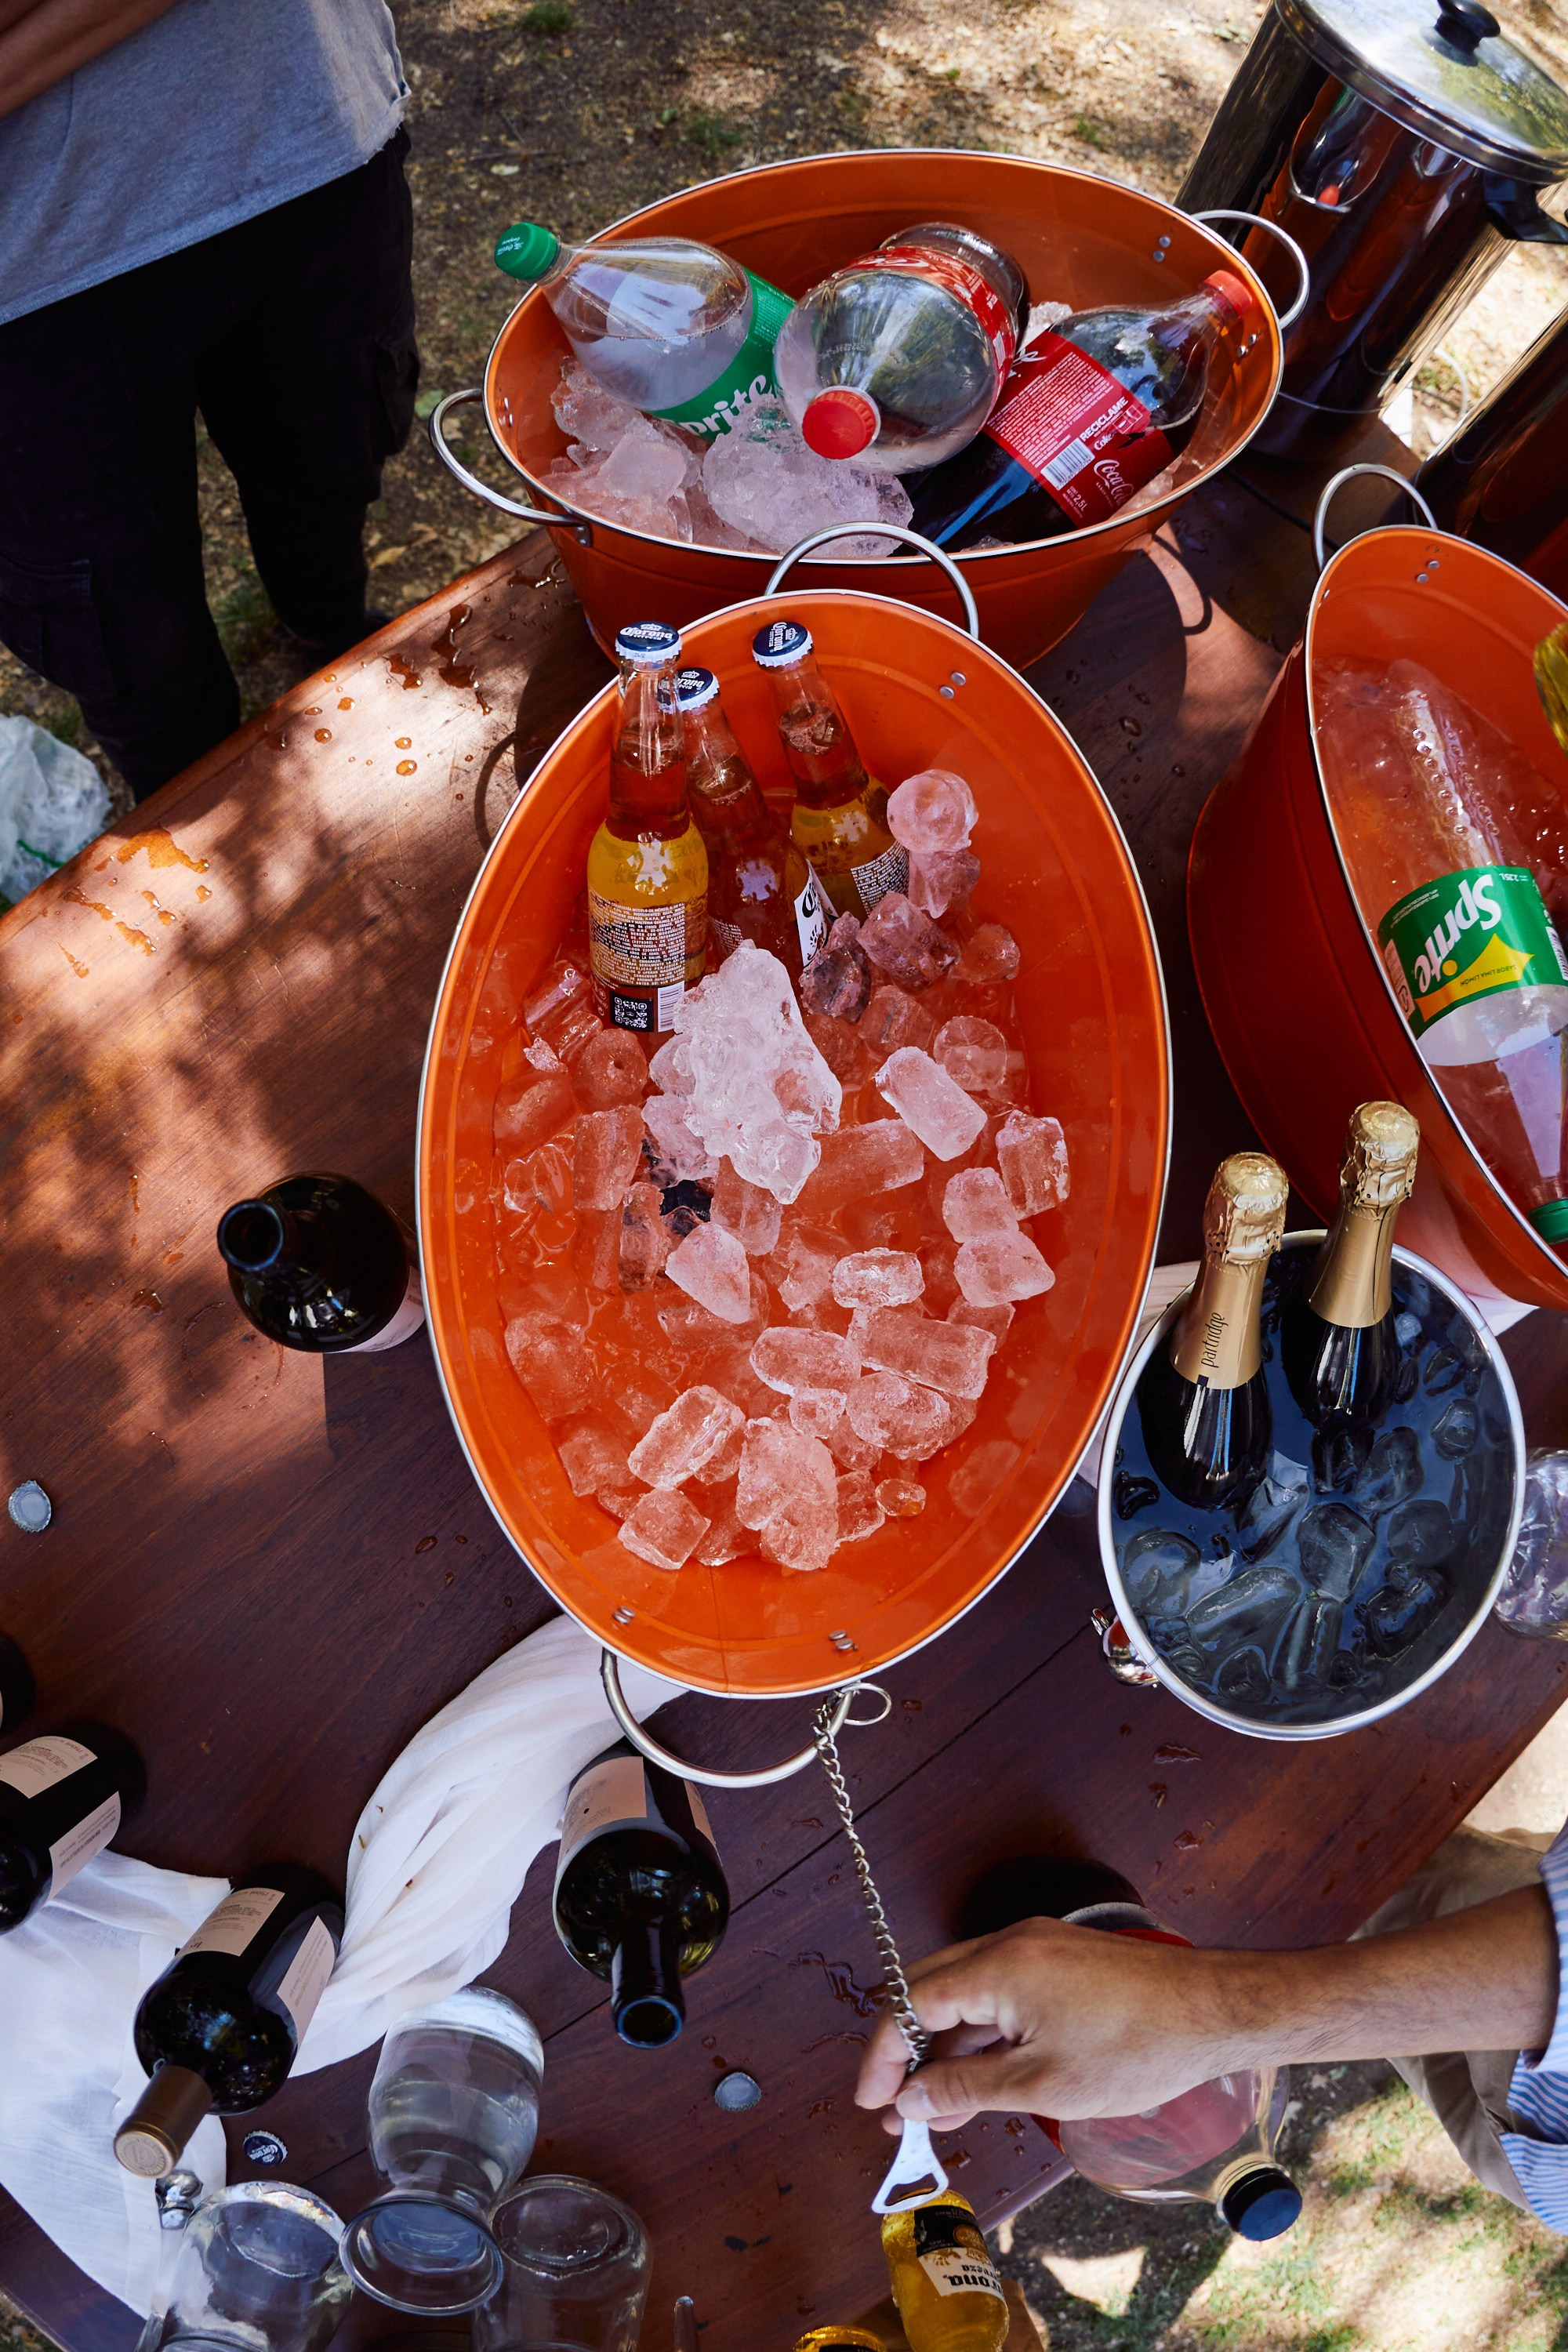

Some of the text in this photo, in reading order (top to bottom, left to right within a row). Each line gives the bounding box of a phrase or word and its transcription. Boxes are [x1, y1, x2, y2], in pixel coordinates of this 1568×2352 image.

[678, 375, 772, 436] prite
[1080, 396, 1128, 442] RECICLAME
[620, 626, 673, 640] Corona
[772, 622, 787, 651] Corona
[1415, 873, 1503, 994] Sprite
[1201, 1311, 1229, 1368] partridge
[249, 2145, 278, 2160] Corona
